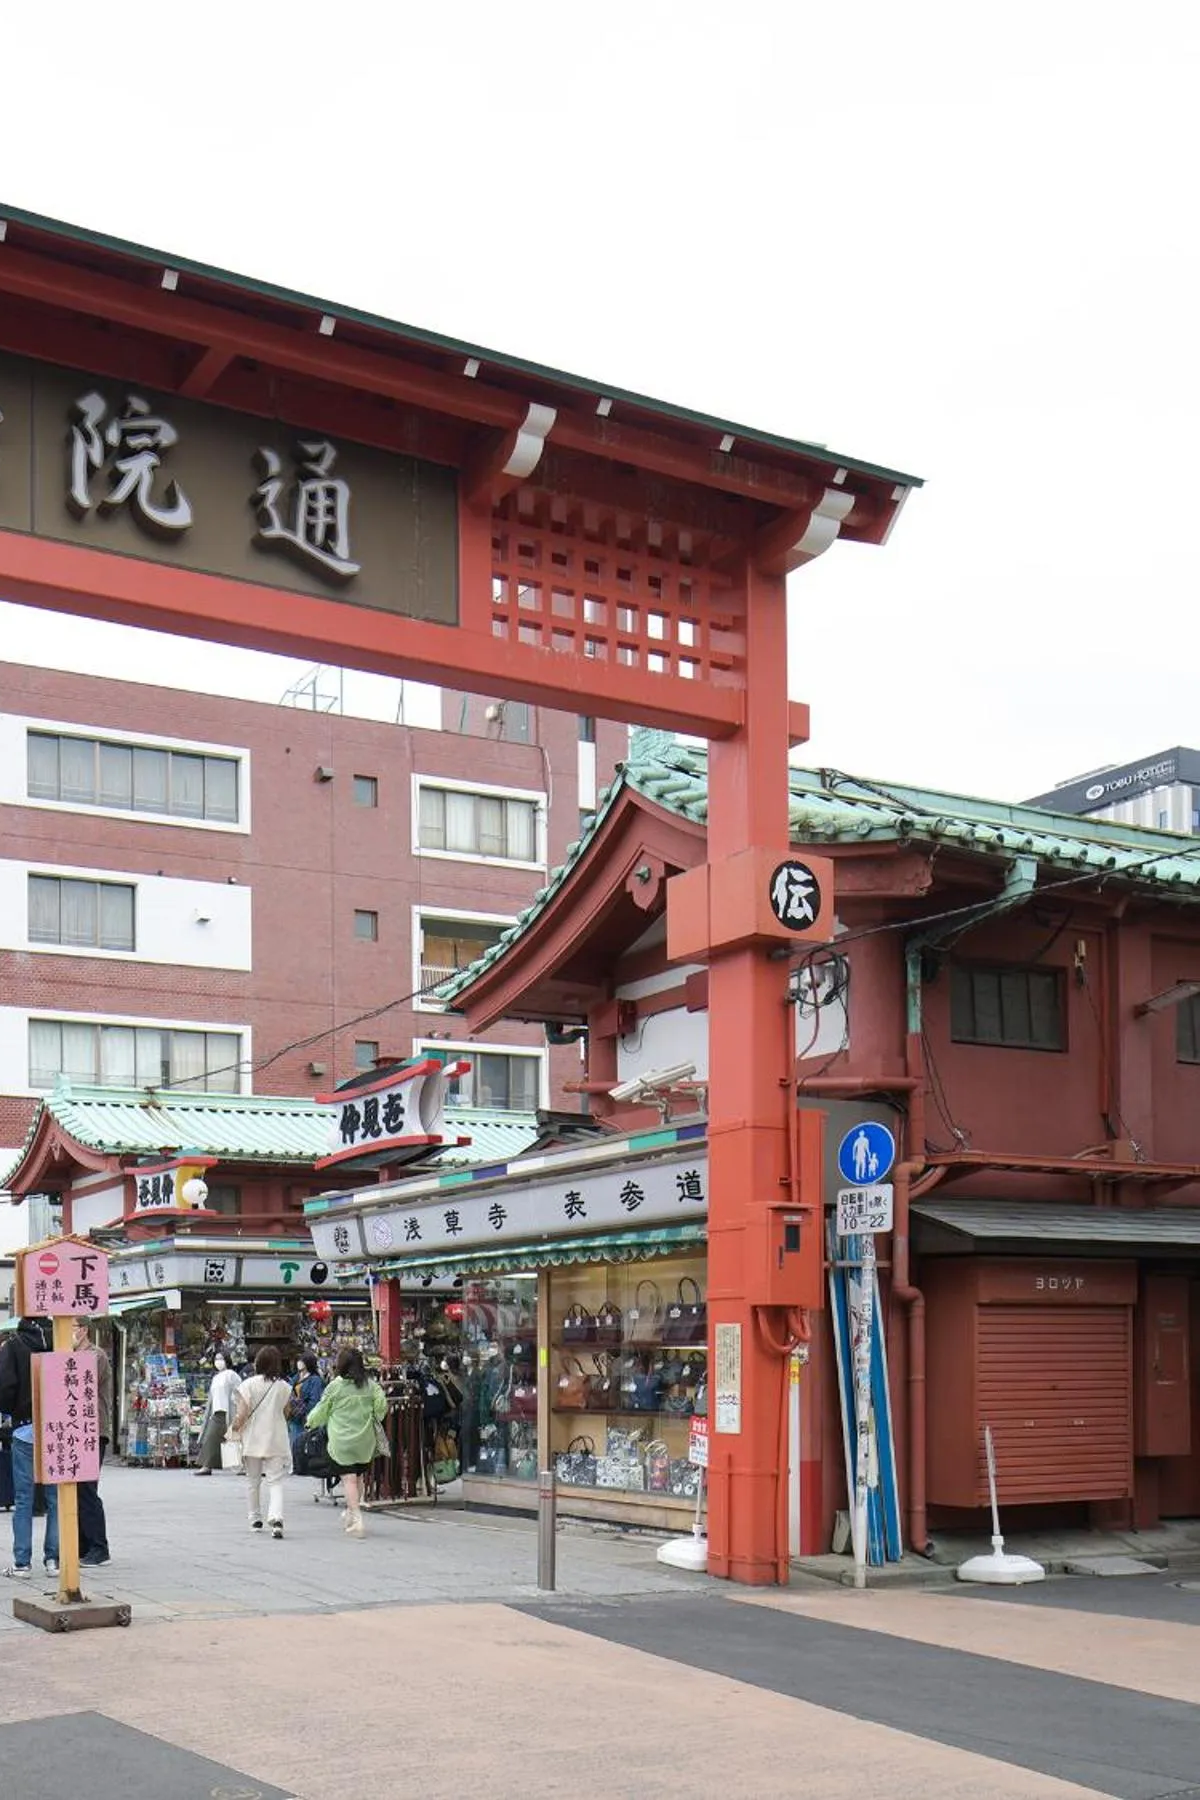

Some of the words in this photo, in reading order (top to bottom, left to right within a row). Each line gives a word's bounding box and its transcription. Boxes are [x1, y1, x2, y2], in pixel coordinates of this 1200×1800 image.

[1104, 776, 1133, 792] TOBU
[771, 866, 815, 923] 伝
[403, 1203, 509, 1242] 浅草寺
[563, 1169, 705, 1221] 表参道
[35, 1279, 49, 1312] 通行止
[69, 1254, 100, 1311] 下馬
